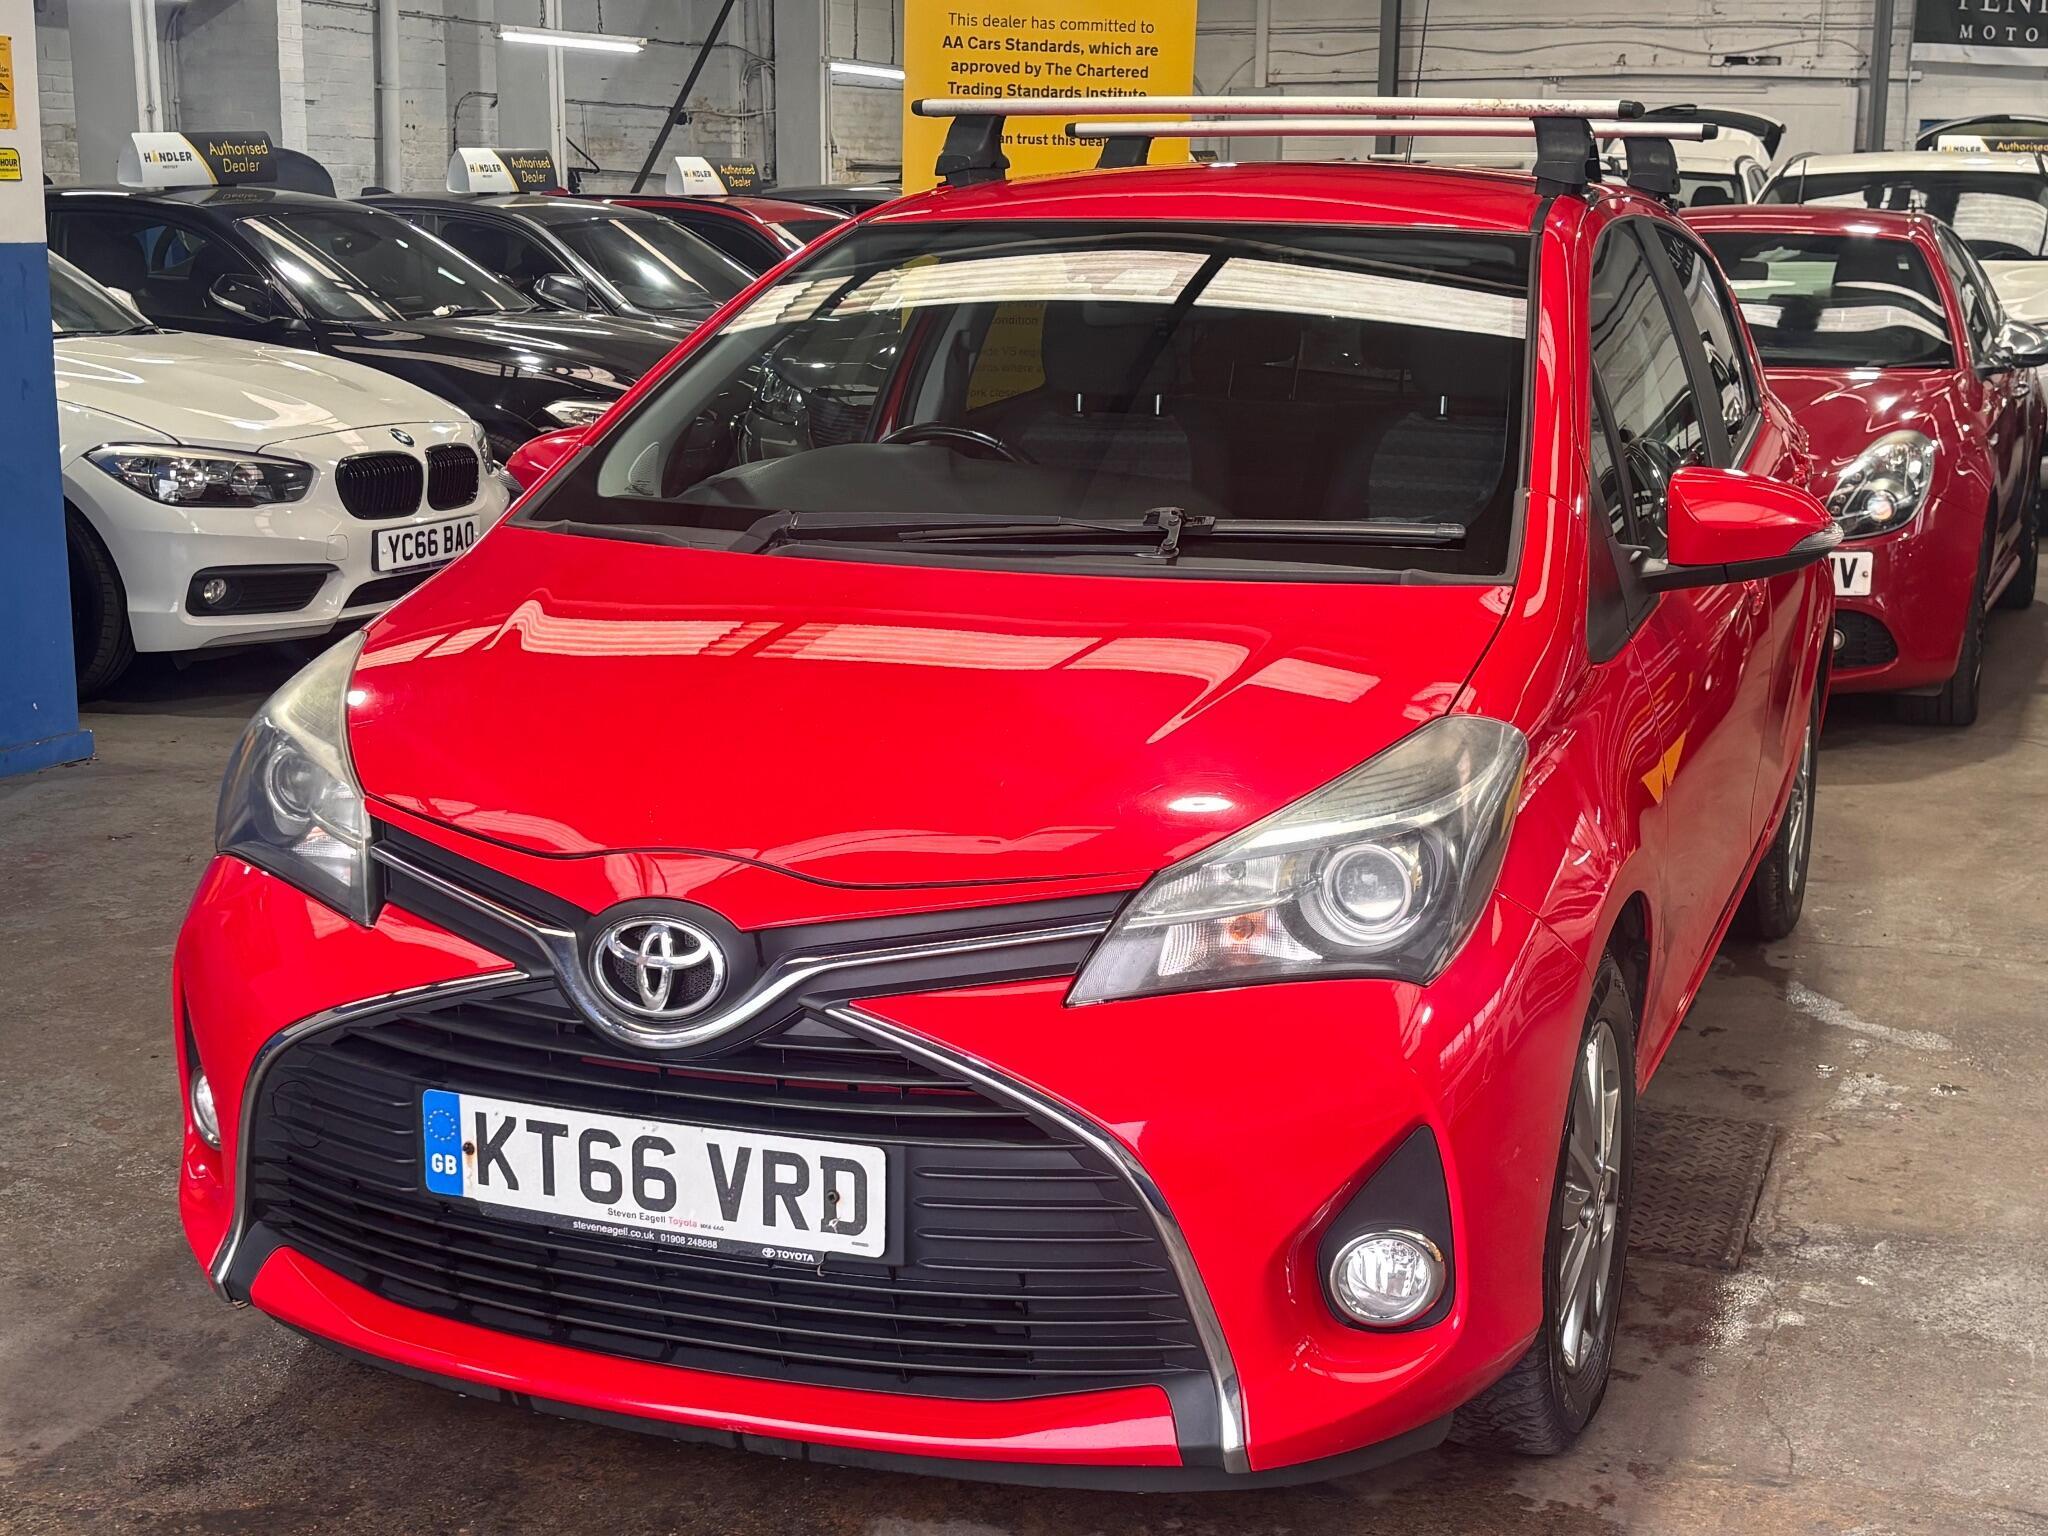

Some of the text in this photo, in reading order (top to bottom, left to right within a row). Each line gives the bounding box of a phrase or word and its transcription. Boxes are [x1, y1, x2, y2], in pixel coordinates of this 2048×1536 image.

[948, 13, 1155, 34] This dealer has committed to
[942, 36, 1159, 56] AA Cars Standards, which are
[951, 61, 1149, 78] approved by The Chartered
[947, 82, 1002, 98] Trading
[1007, 84, 1082, 98] Standards
[1017, 133, 1048, 145] trust
[1052, 134, 1076, 146] this
[209, 140, 269, 157] Authorised
[223, 158, 260, 173] Dealer
[511, 156, 551, 169] Authorised
[720, 164, 756, 175] Authorised
[521, 170, 547, 183] Dealer
[728, 176, 751, 187] Dealer
[388, 521, 474, 563] YC66 BAO
[431, 1152, 457, 1175] GB
[474, 1111, 868, 1237] KT66 VRD
[608, 1207, 637, 1220] Steven
[639, 1212, 666, 1224] Eagell
[668, 1216, 697, 1228] Toyota
[573, 1220, 655, 1240] steveneagell.co.uk
[660, 1233, 686, 1244] 01908
[776, 1249, 815, 1262] TOYOTA
